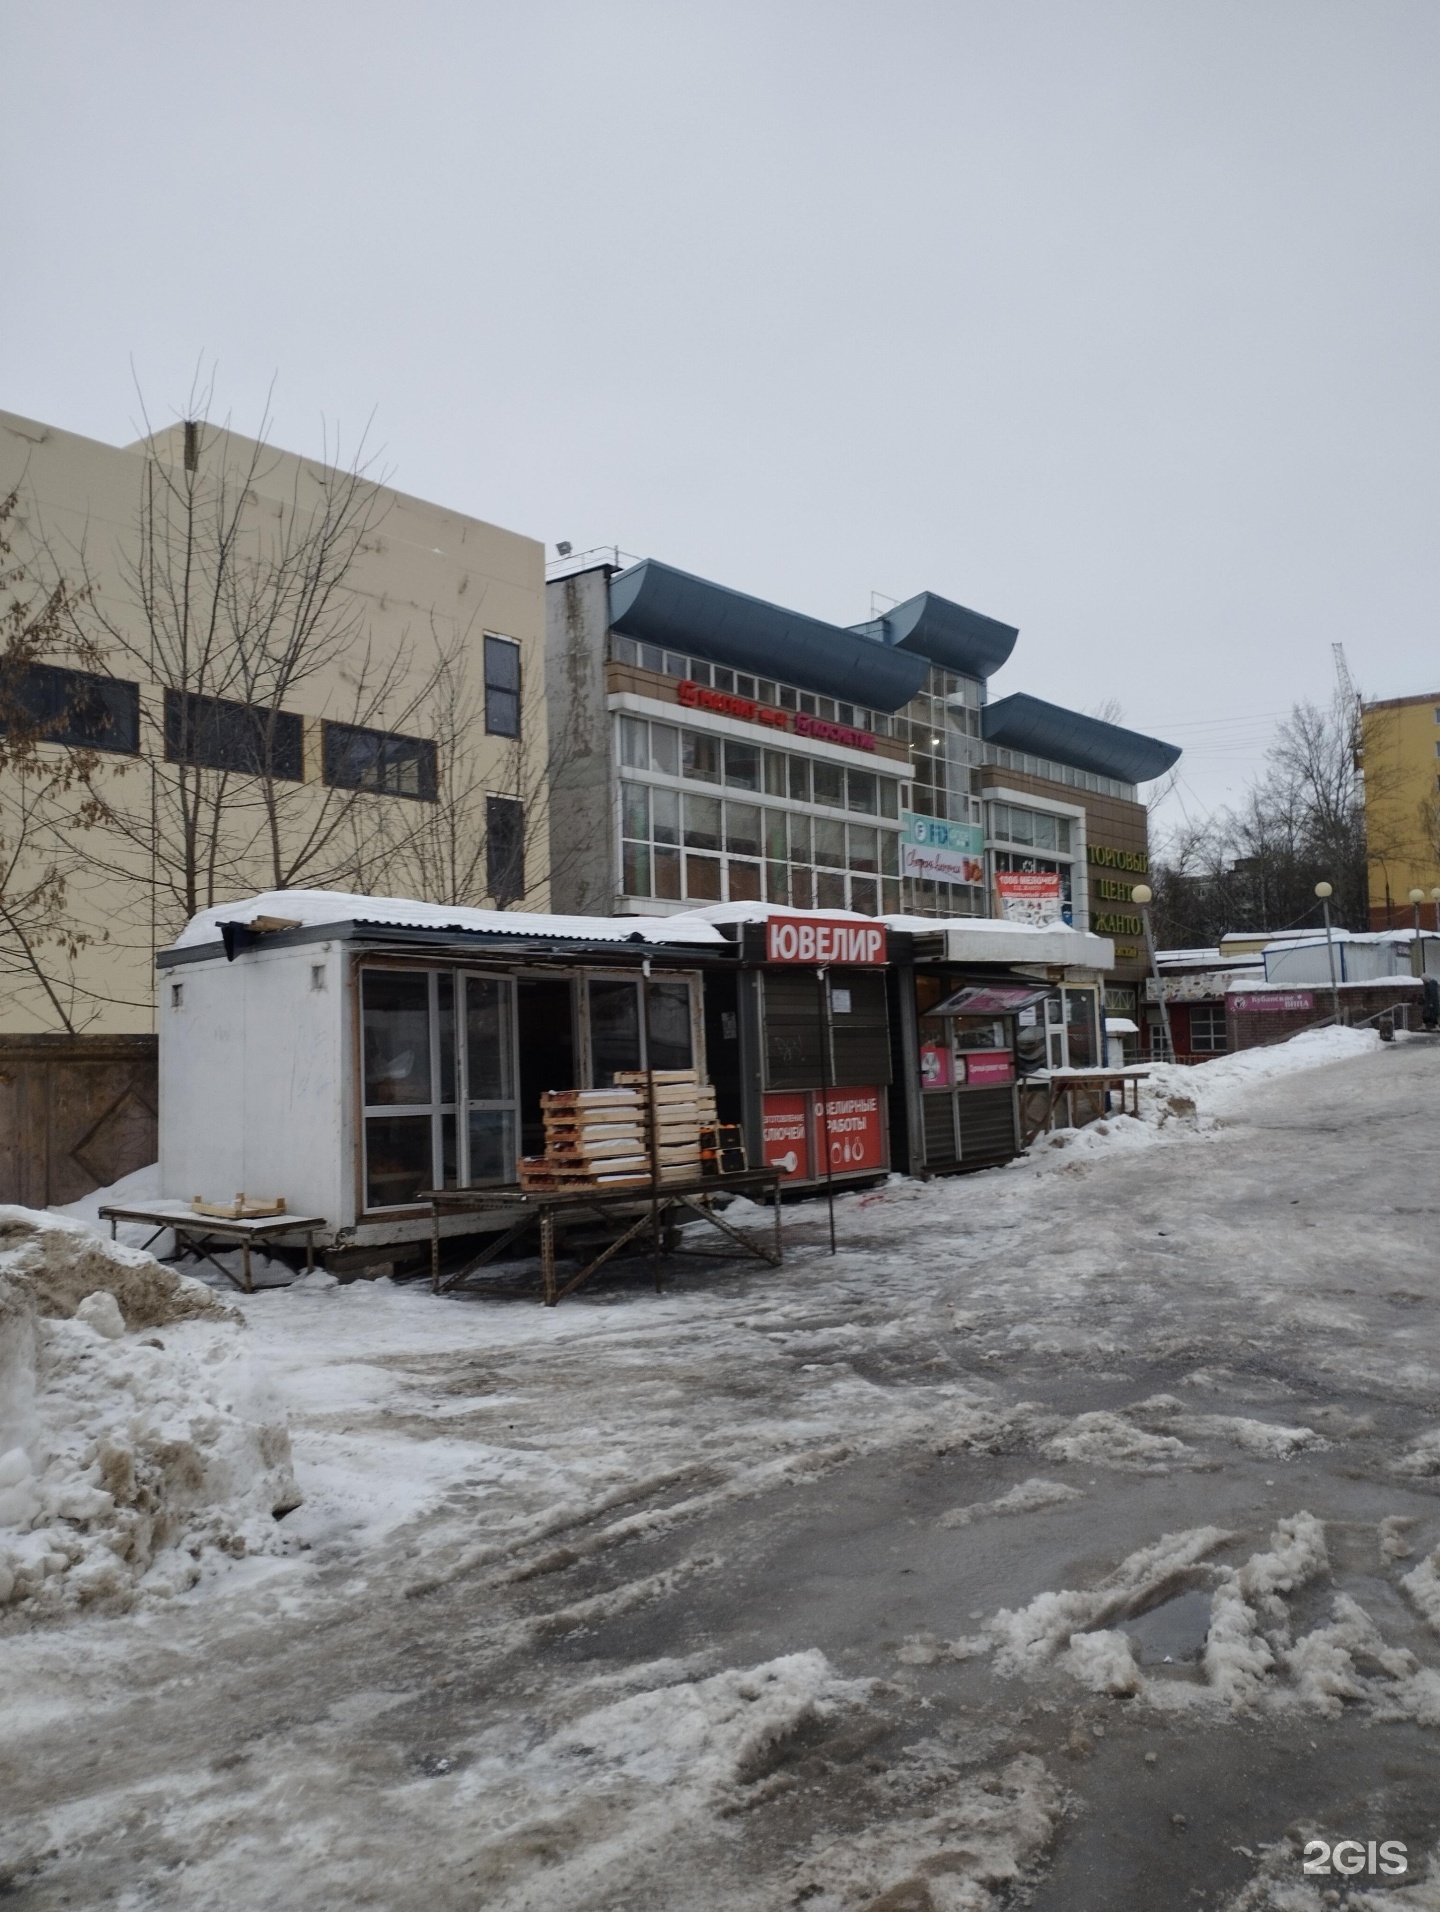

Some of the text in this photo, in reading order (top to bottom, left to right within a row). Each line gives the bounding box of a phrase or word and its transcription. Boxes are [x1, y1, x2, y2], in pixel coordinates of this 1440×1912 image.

[1088, 844, 1151, 874] ТОРГОВЫЙ
[1100, 879, 1136, 902] ЦЕНТ
[771, 924, 882, 961] ЮВЕЛИР
